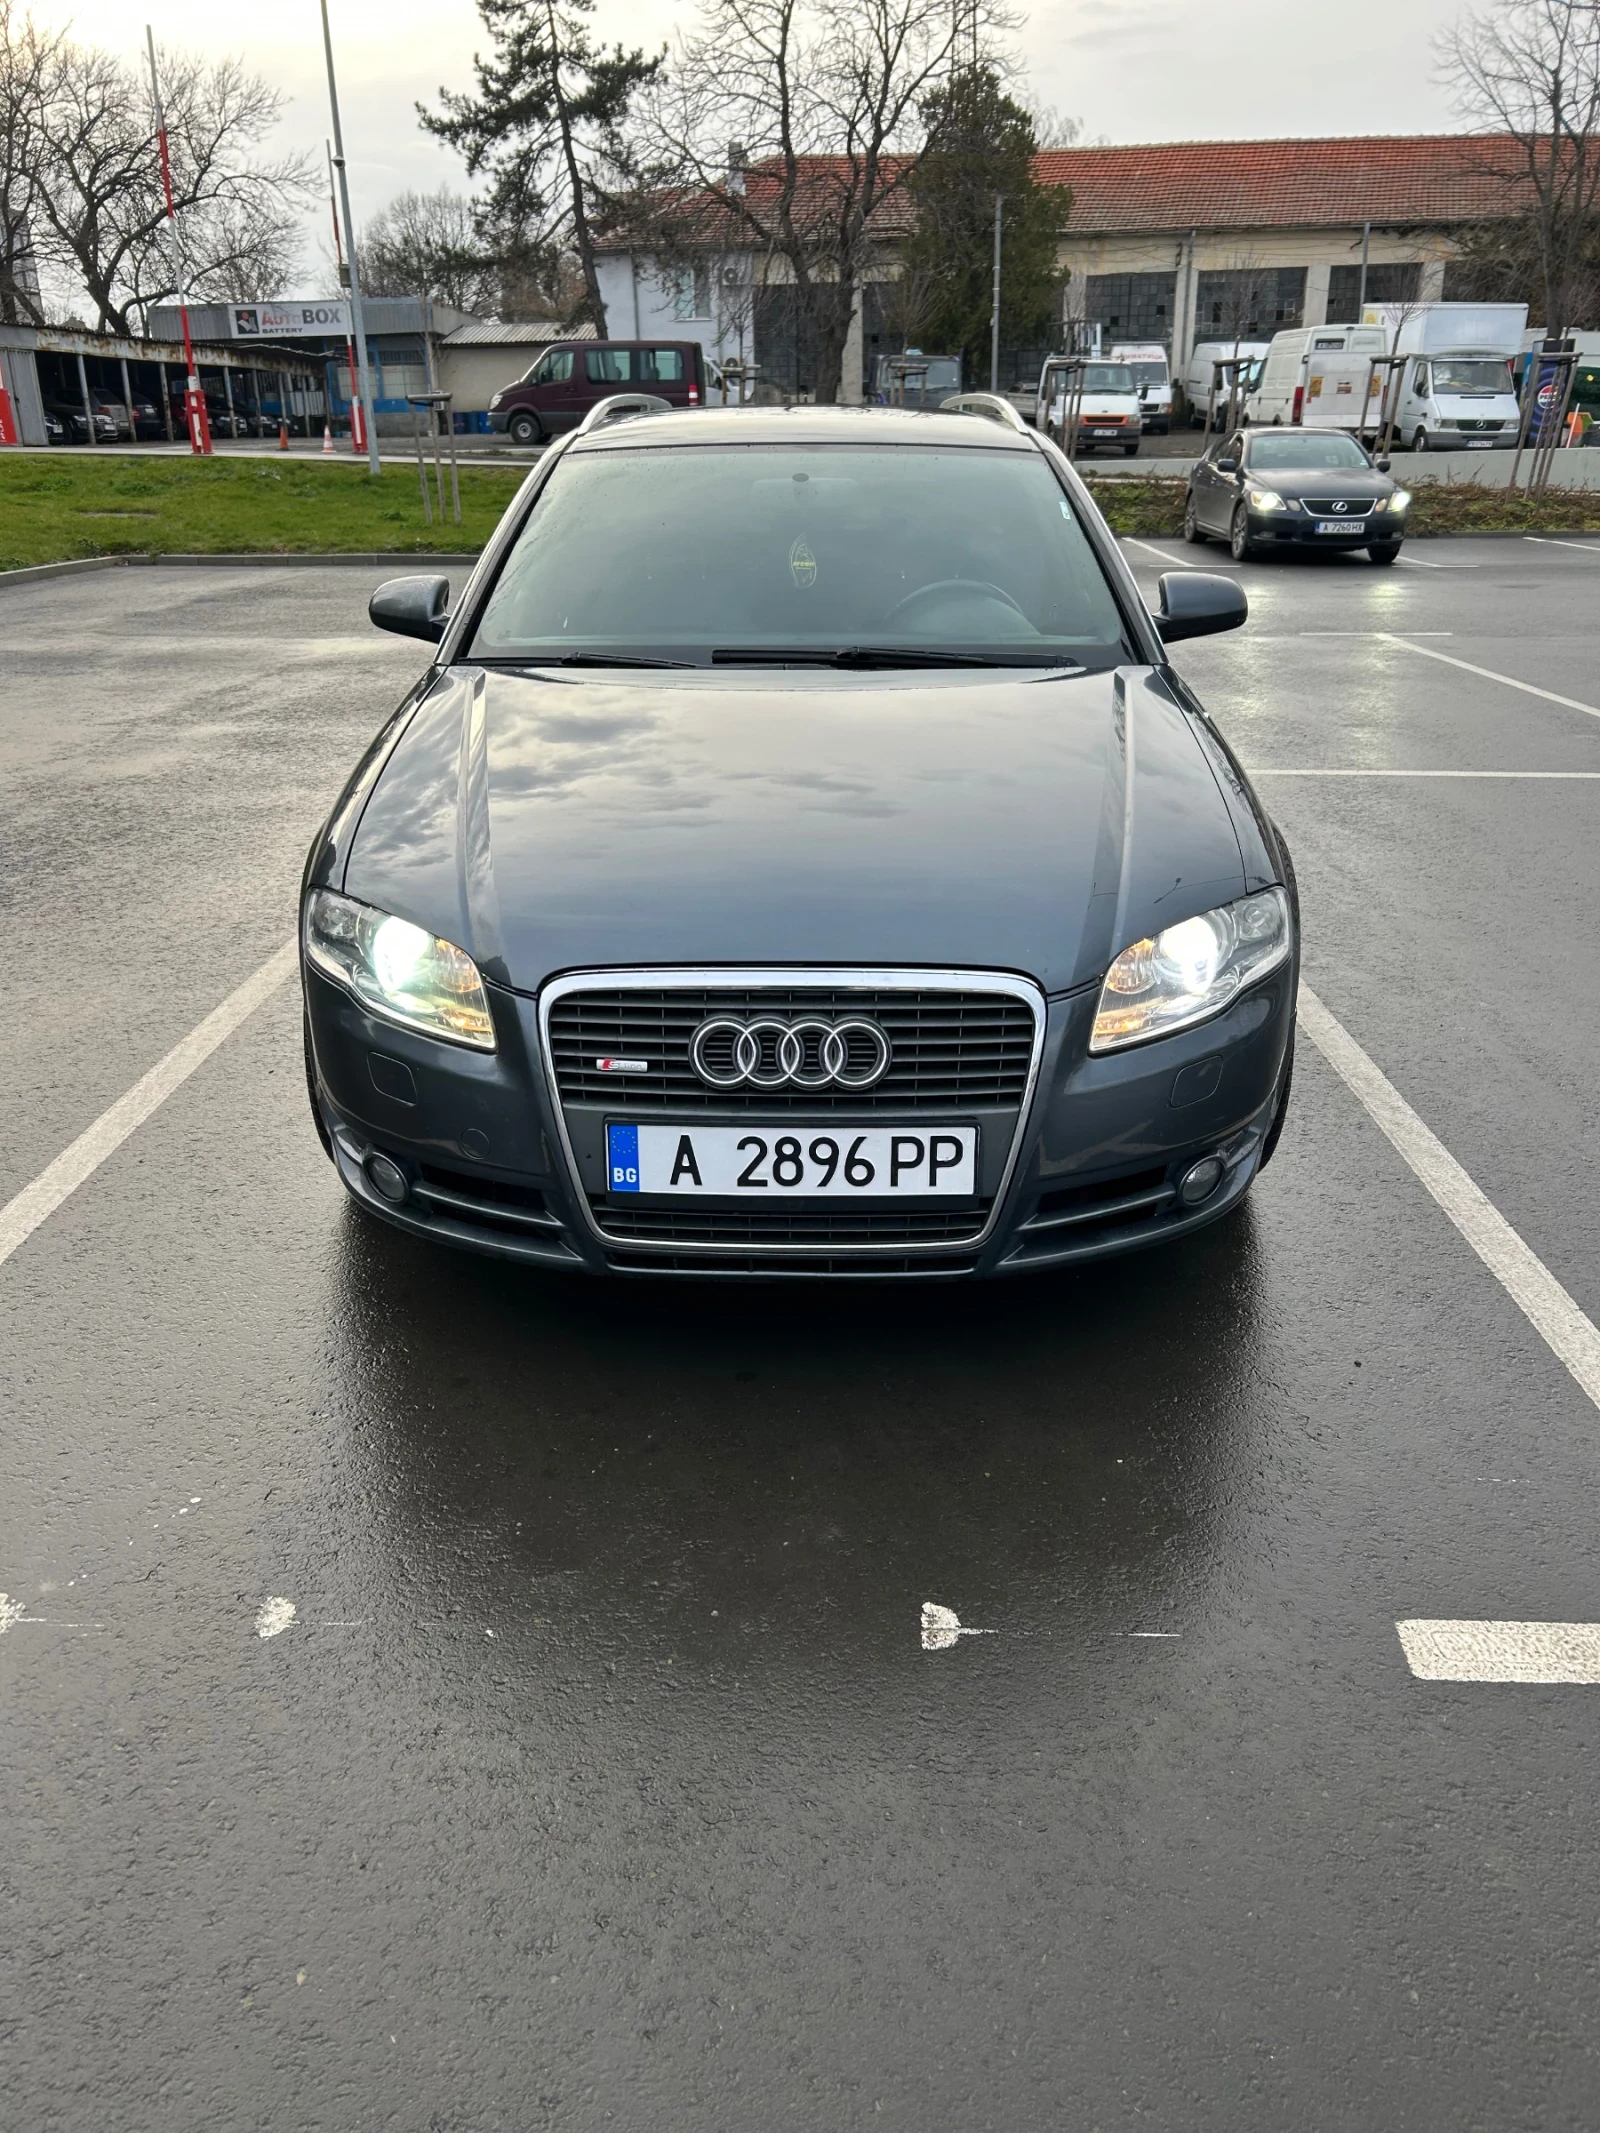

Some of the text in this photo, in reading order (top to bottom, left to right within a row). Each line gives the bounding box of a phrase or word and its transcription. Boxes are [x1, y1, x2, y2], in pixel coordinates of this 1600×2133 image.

[613, 1167, 637, 1183] BG
[669, 1134, 964, 1188] A 2896 PP
